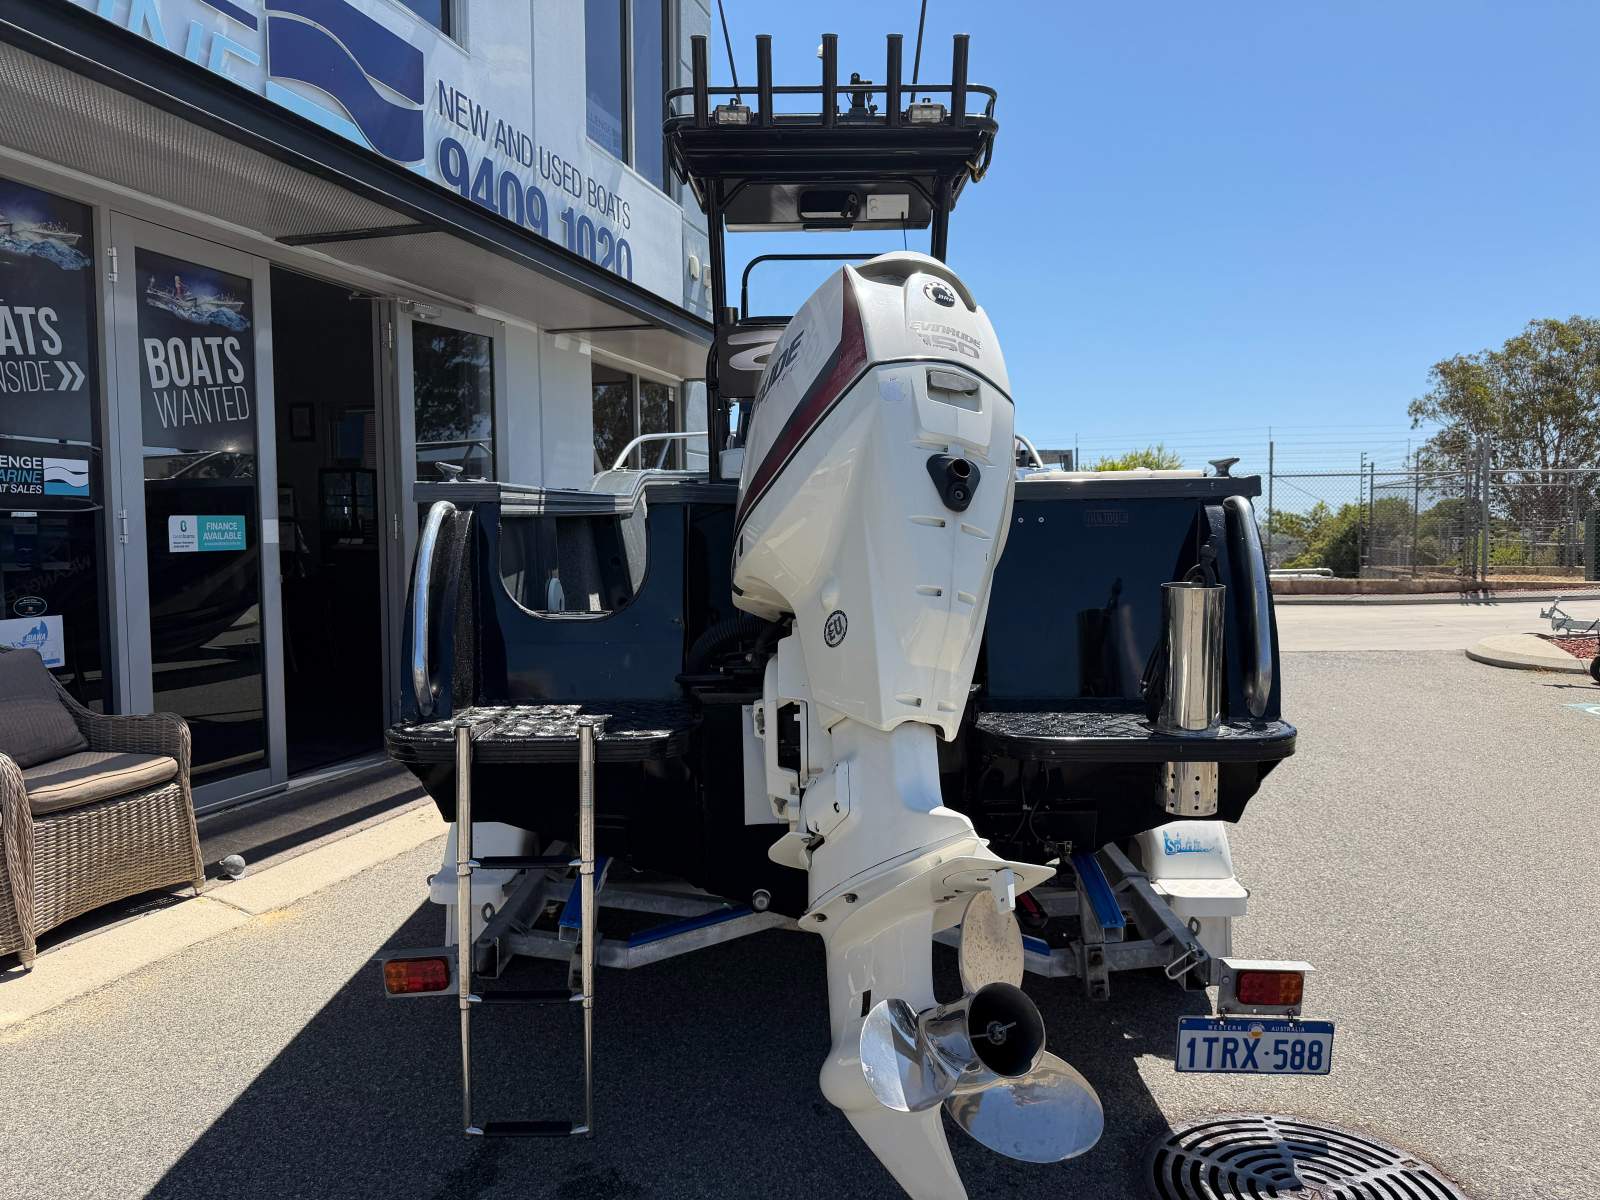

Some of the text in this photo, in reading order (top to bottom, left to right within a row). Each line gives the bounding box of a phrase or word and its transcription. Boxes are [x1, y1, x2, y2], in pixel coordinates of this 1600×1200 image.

[437, 79, 489, 142] NEW
[494, 118, 534, 169] AND
[539, 146, 583, 199] USED
[586, 177, 632, 231] BOATS
[438, 137, 633, 282] 9409 1020
[144, 336, 245, 389] BOATS
[153, 385, 250, 429] WANTED
[10, 484, 42, 494] SALES
[203, 531, 242, 541] AVAILABLE
[206, 522, 238, 530] FINANCE
